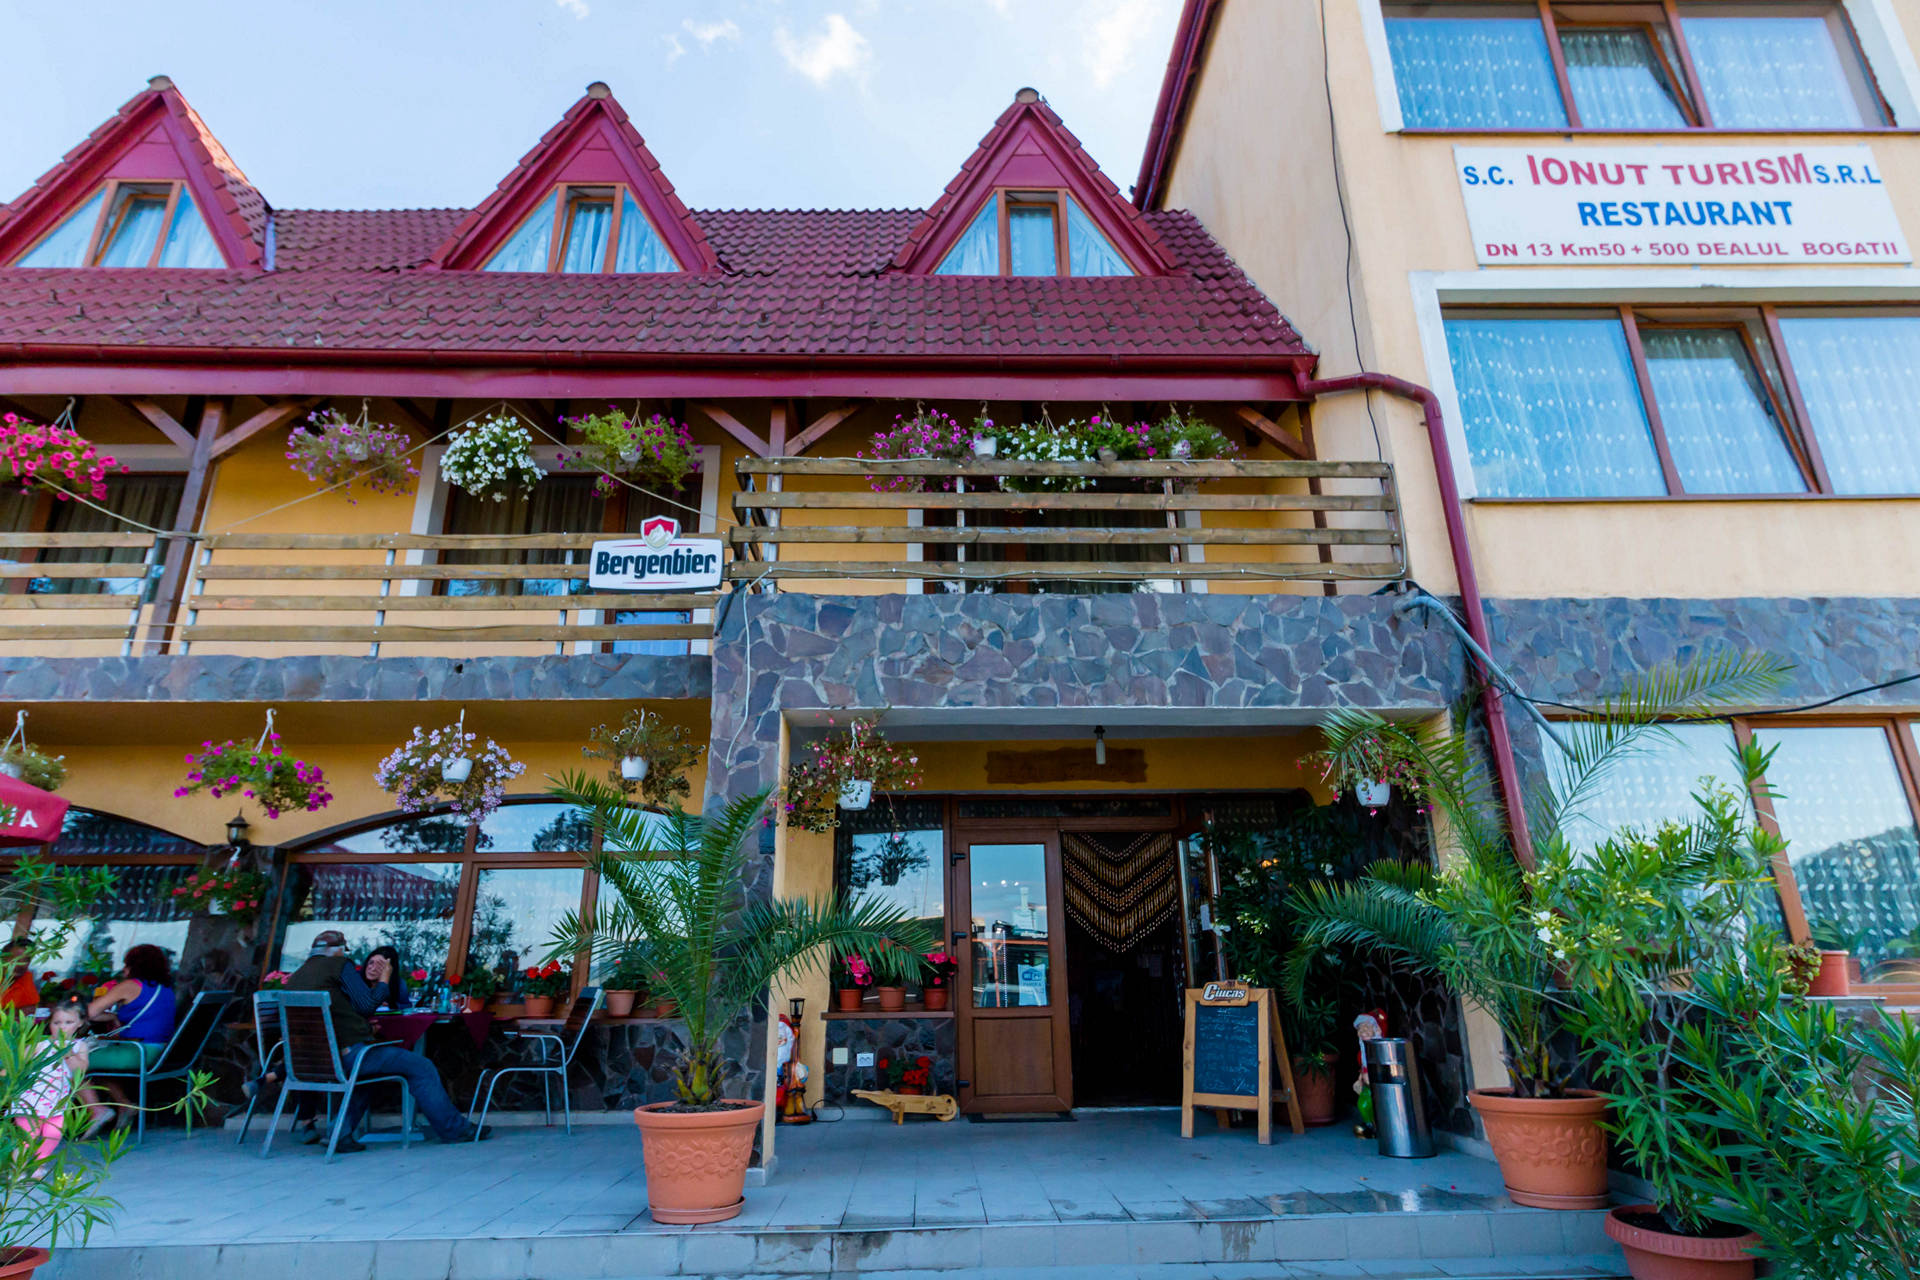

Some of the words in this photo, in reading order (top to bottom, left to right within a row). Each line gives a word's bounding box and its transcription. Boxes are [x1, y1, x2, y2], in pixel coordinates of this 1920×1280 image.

[1463, 166, 1514, 185] S.C.
[1526, 154, 1648, 185] IONUT
[1662, 153, 1812, 185] TURISM
[1813, 165, 1882, 184] S.R.L
[1577, 202, 1793, 226] RESTAURANT
[1486, 243, 1518, 257] DN
[1526, 243, 1553, 256] 13
[1560, 243, 1626, 256] Km50
[1649, 242, 1689, 256] 500
[1697, 242, 1789, 256] DEALUL
[1802, 242, 1898, 256] BOGATII
[595, 548, 717, 579] Bergenbier
